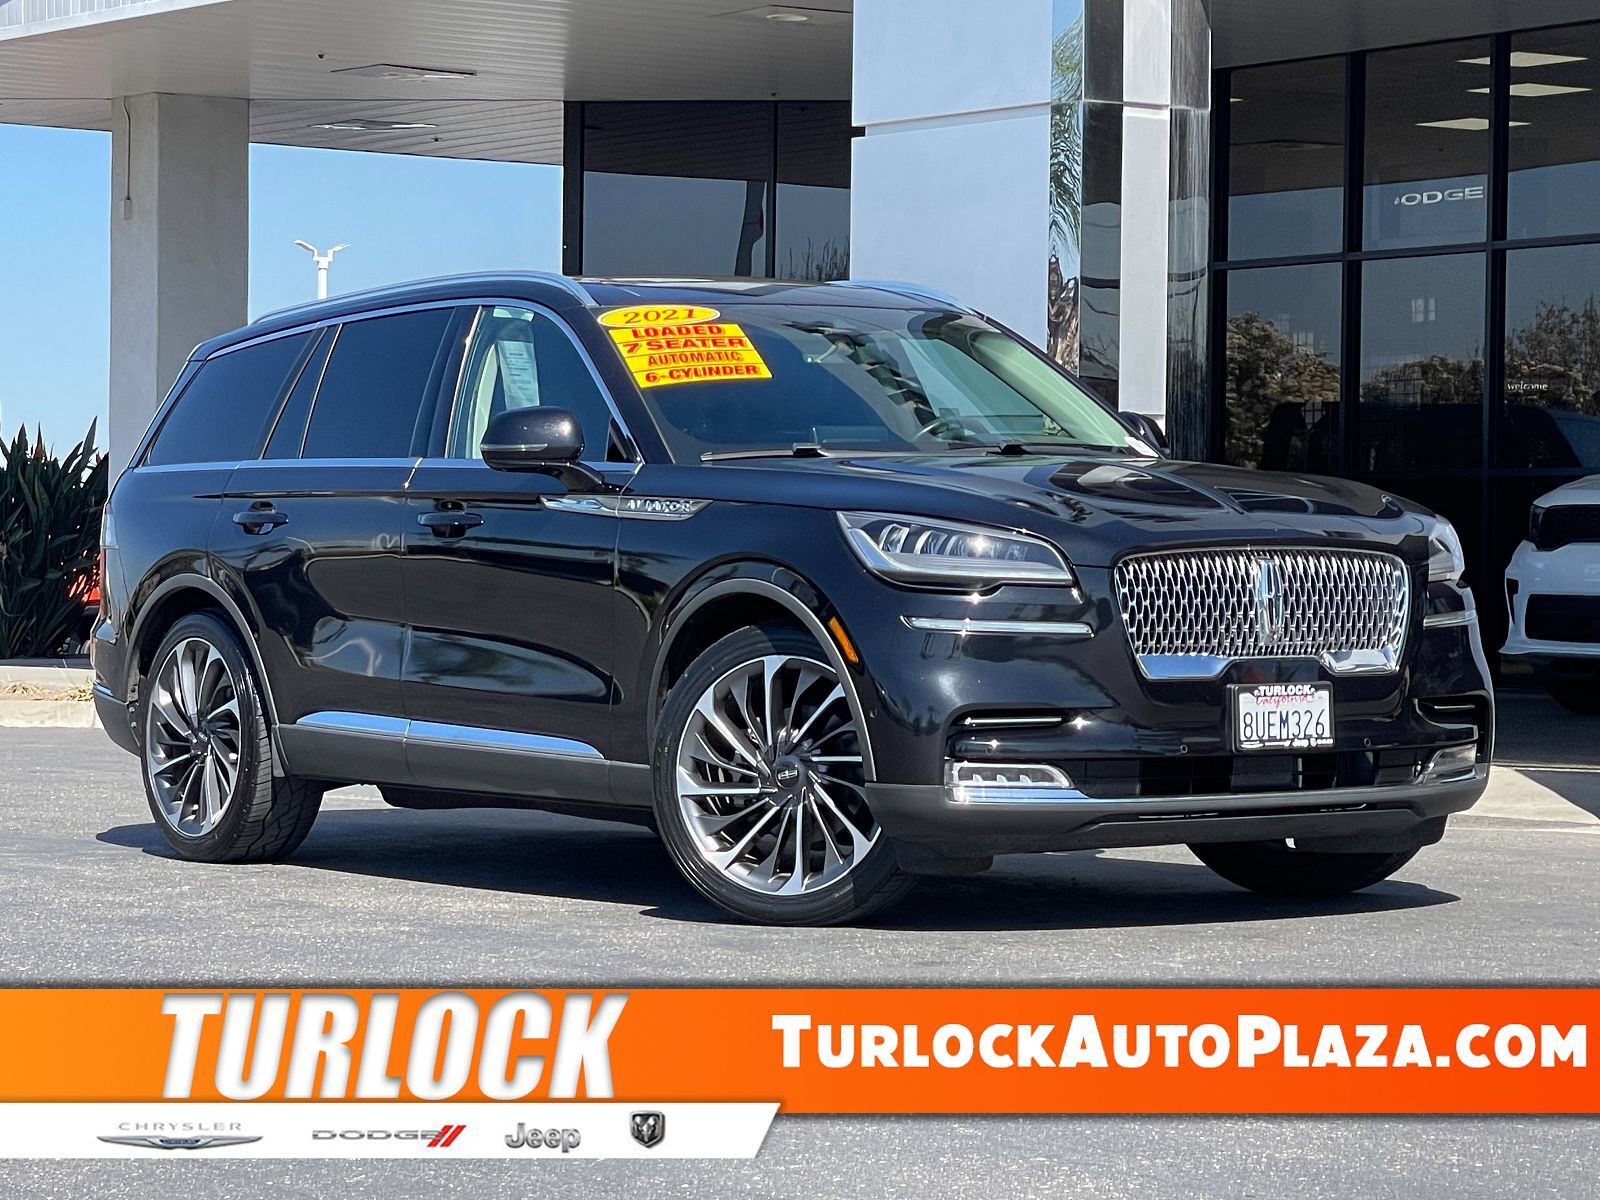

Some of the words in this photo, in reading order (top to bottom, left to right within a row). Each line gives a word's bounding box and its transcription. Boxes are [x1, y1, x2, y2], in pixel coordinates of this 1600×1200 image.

[1394, 186, 1484, 206] ODGE
[623, 308, 698, 325] 2021
[631, 325, 726, 340] LOADED
[623, 342, 640, 354] 7
[646, 337, 747, 352] SEATER
[648, 350, 744, 367] AUTOMATIC
[645, 365, 761, 383] 6-CYLINDER
[1507, 380, 1548, 391] welcome
[1257, 684, 1312, 696] TURLOCK
[1243, 708, 1326, 741] 8UEM326
